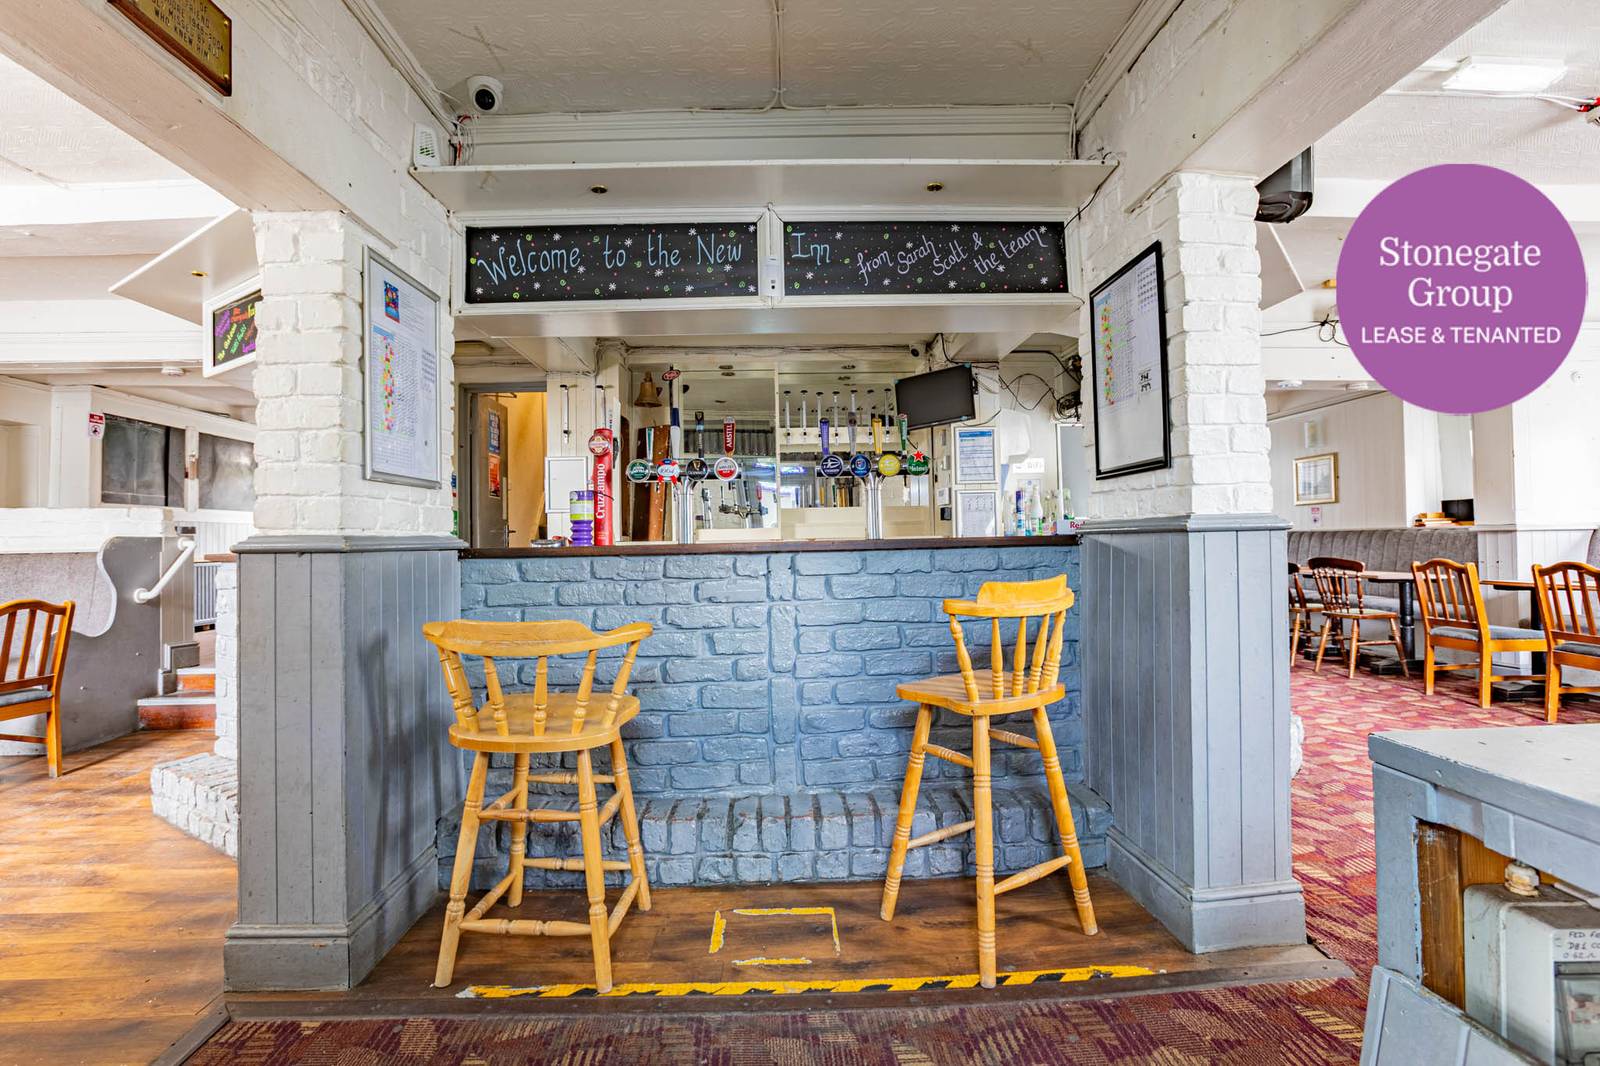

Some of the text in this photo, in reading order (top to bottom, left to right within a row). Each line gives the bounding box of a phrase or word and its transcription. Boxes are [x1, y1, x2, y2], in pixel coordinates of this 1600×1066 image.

[477, 233, 743, 286] Welcome to the New
[791, 231, 831, 265] Inn
[856, 249, 895, 287] from
[932, 230, 984, 277] Scott &
[974, 226, 1049, 276] the team
